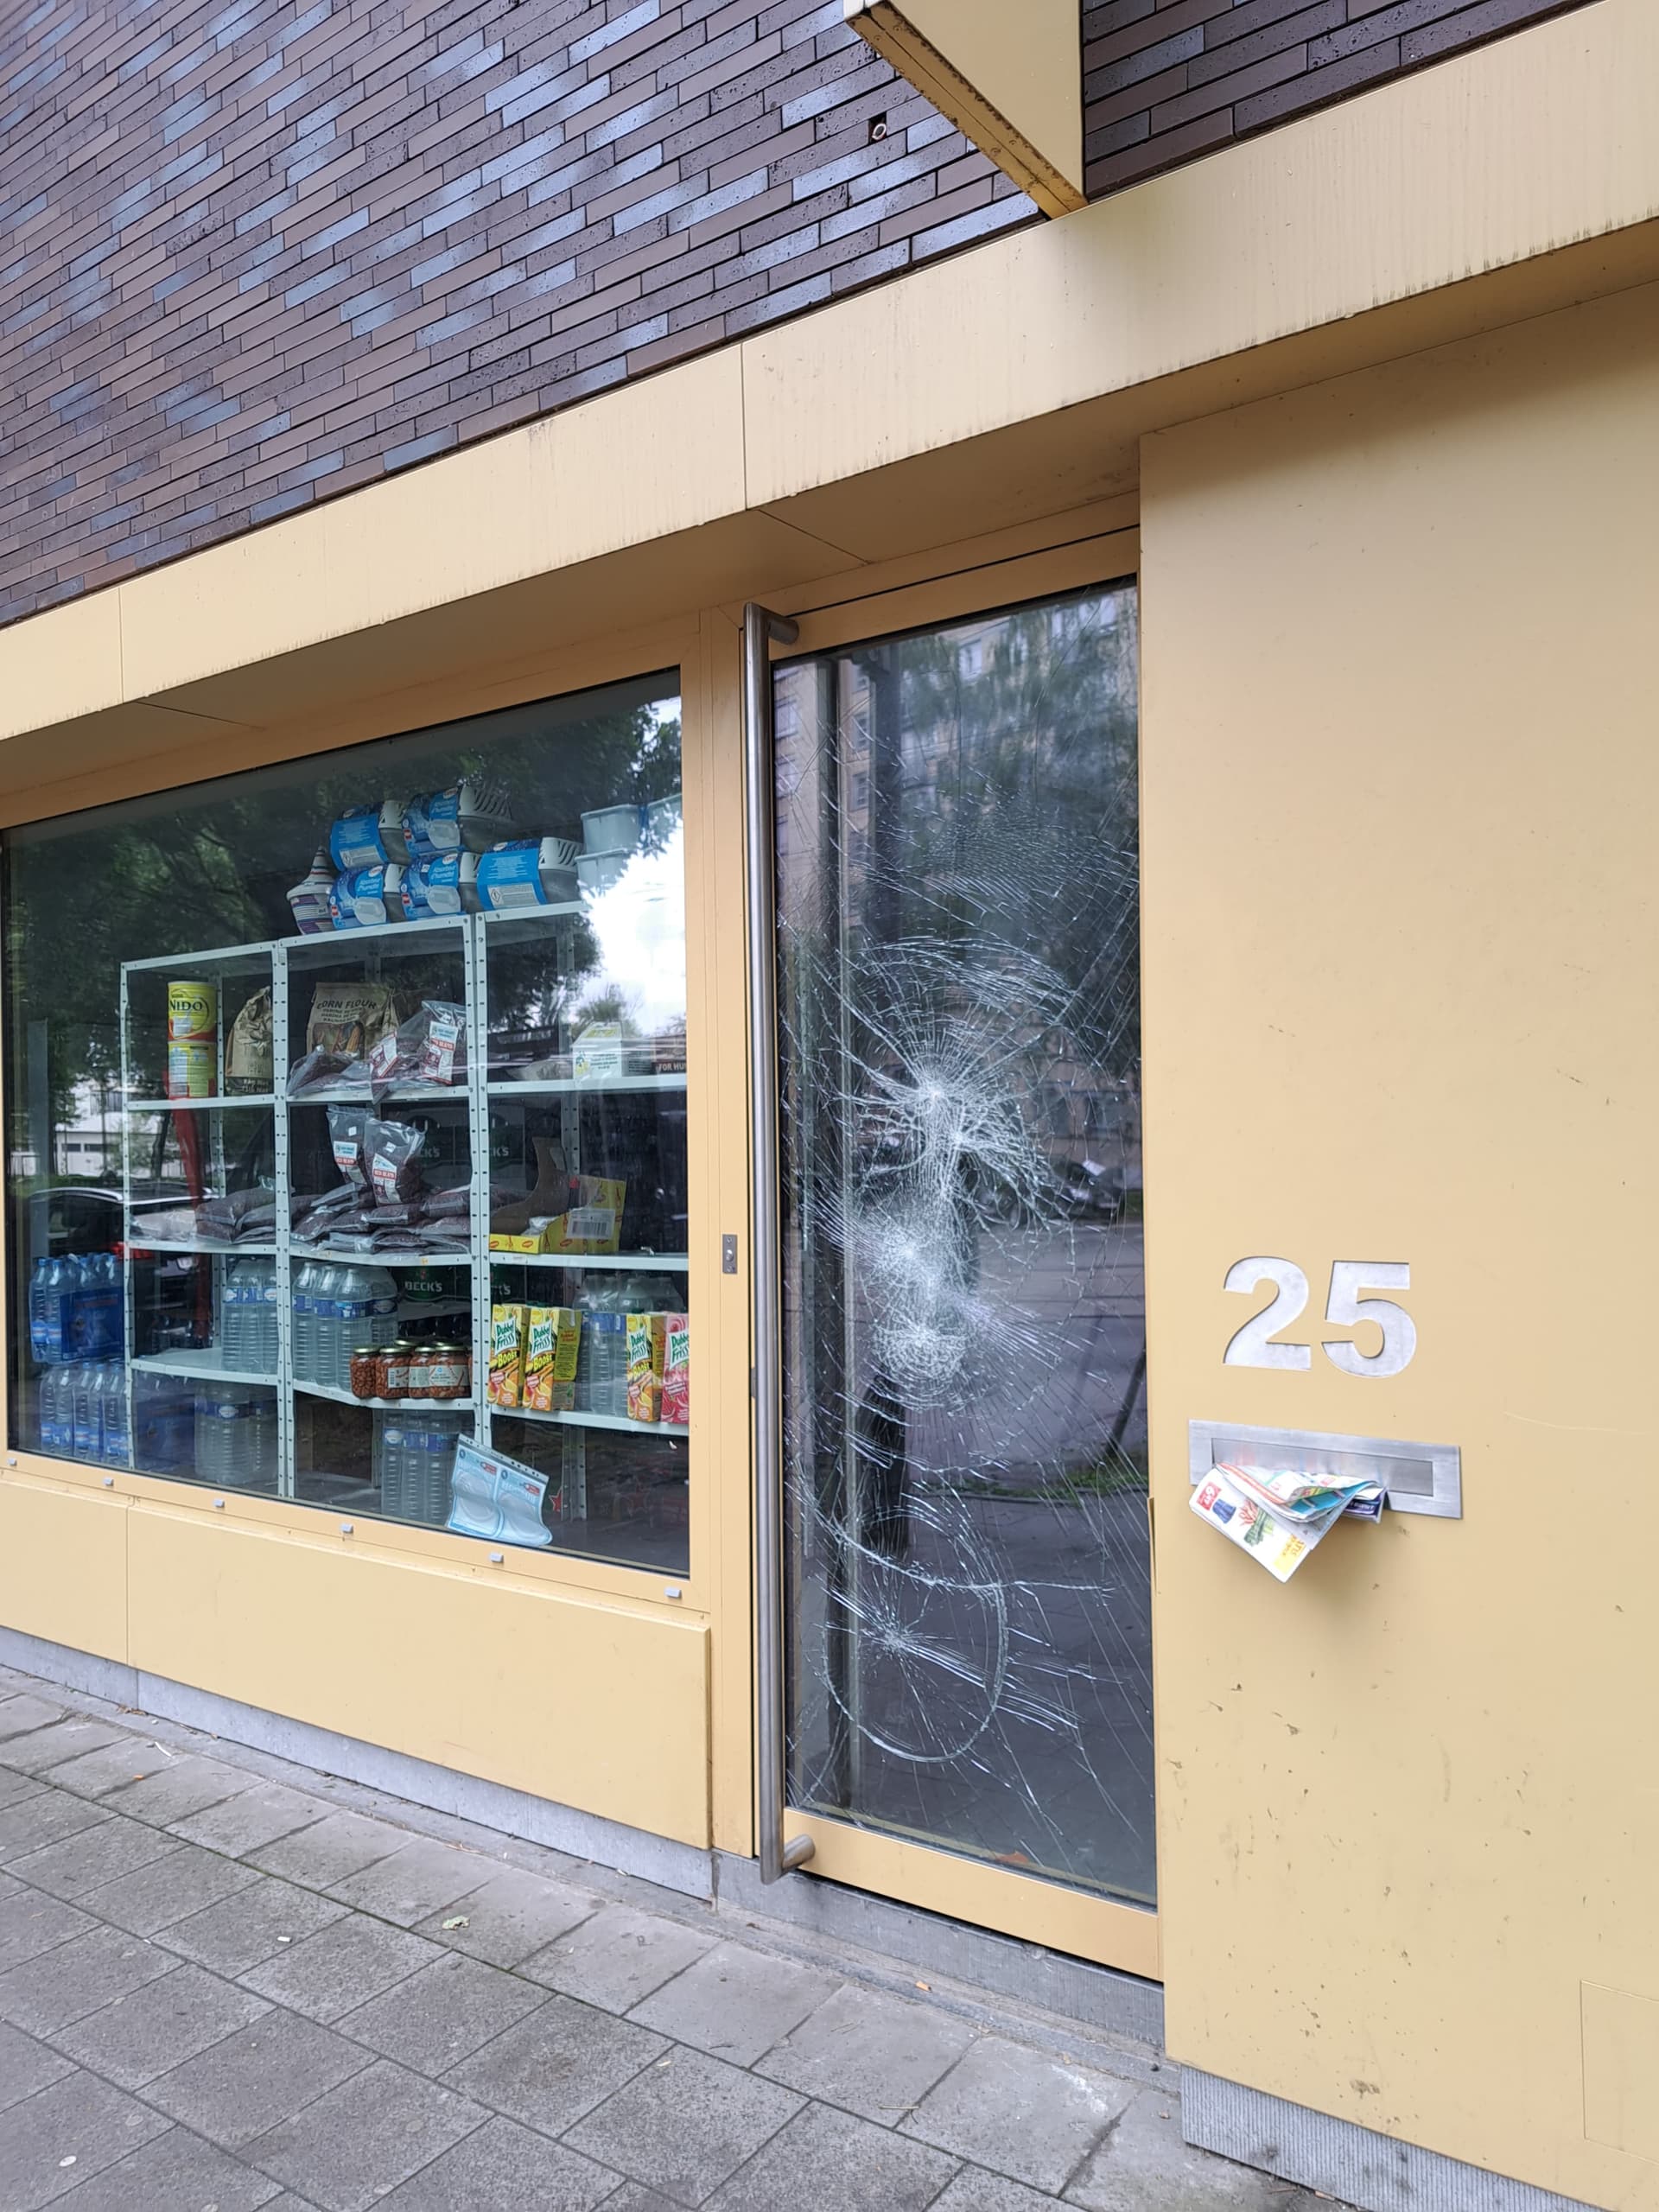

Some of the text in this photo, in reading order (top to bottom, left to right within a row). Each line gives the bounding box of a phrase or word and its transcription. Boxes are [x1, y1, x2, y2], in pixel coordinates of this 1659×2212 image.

[169, 1000, 202, 1012] NIDO
[316, 999, 377, 1009] CORN FLOUR
[404, 1280, 443, 1293] BECK'S
[1223, 1255, 1417, 1378] 25
